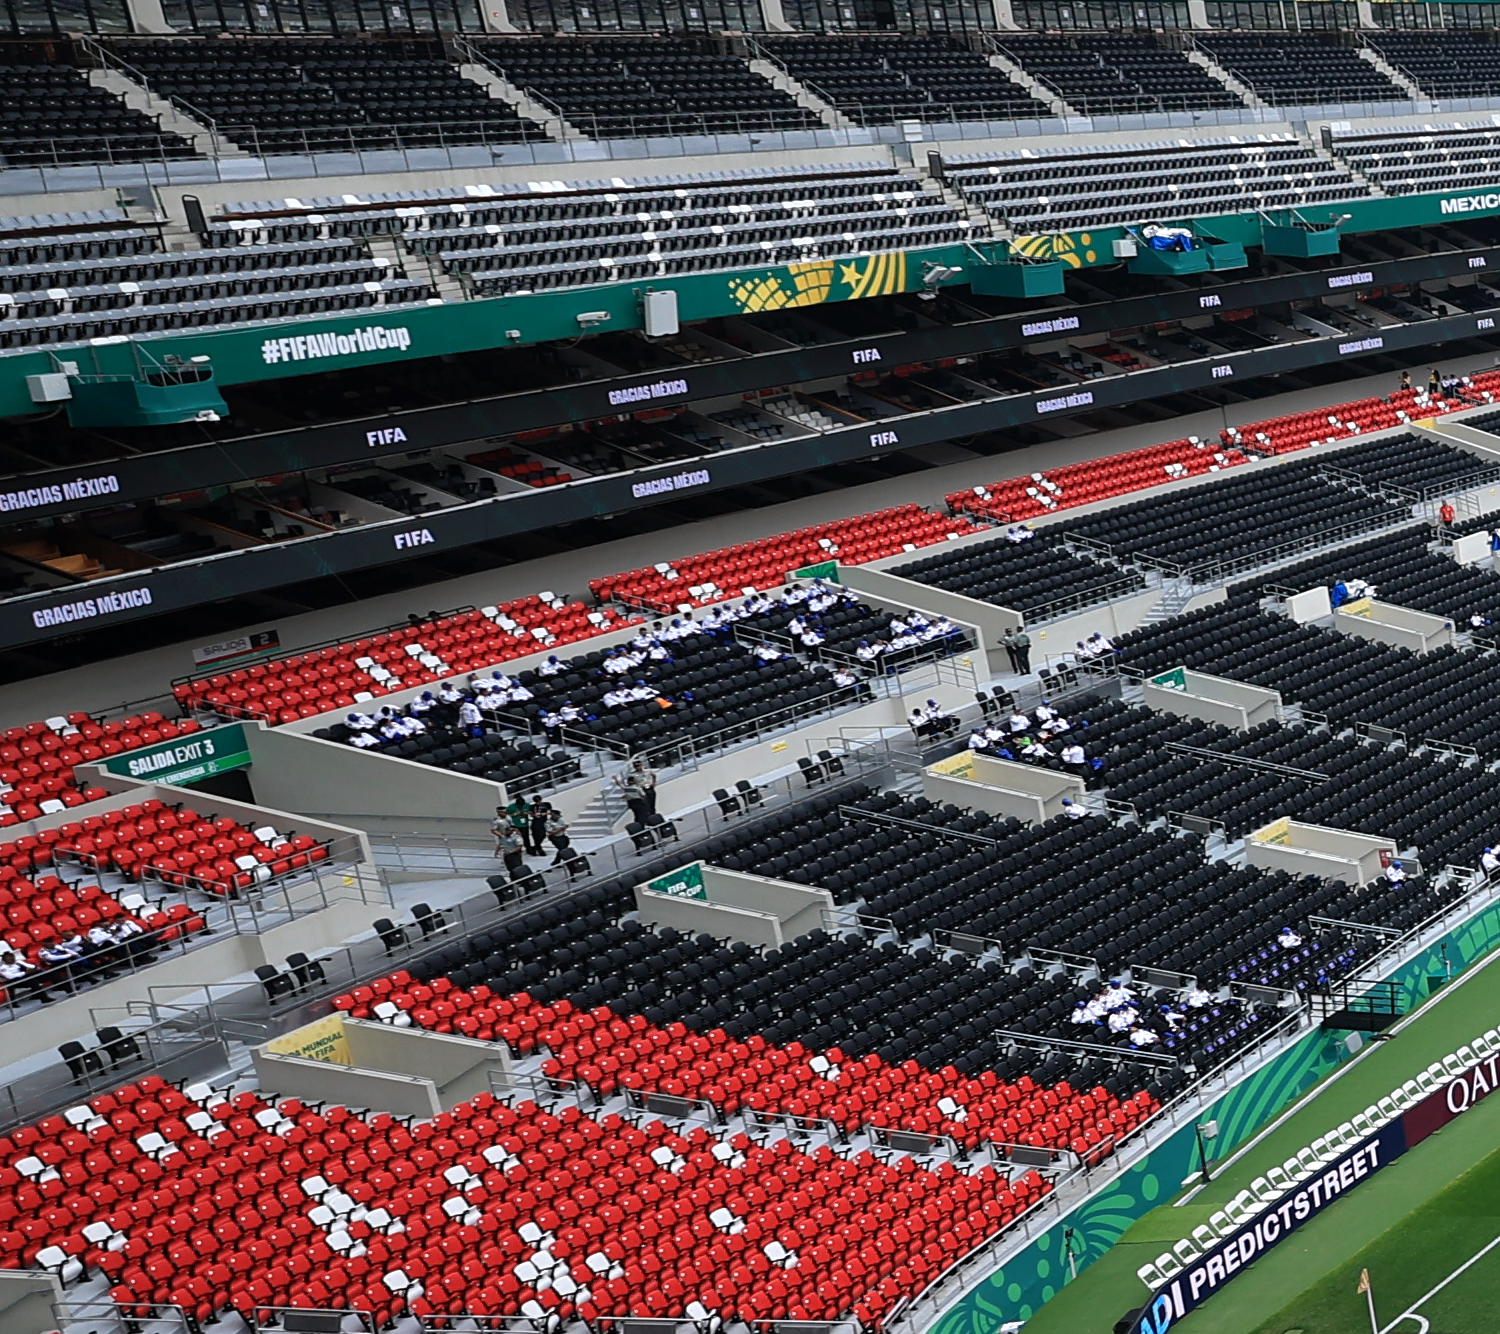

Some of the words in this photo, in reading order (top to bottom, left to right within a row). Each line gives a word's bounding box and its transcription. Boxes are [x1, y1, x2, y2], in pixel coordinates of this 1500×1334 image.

[261, 325, 412, 365] #FIFAWorldCup
[853, 349, 881, 363] FIFA
[609, 386, 650, 405] GRACIAS
[651, 380, 687, 397] MÉXICO
[367, 428, 406, 446] FIFA
[870, 432, 898, 447] FIFA
[0, 486, 62, 511] GRACIAS
[63, 476, 119, 500] MÉXICO
[632, 478, 673, 497] GRACIAS
[674, 470, 709, 489] MÉXICO
[394, 529, 434, 549] FIFA
[33, 600, 96, 627] GRACIAS
[97, 588, 151, 614] MÉXICO
[204, 638, 247, 655] SALIDA
[260, 634, 270, 644] 2
[129, 750, 176, 776] SALIDA
[174, 741, 202, 764] EXIT
[203, 739, 215, 755] 3
[303, 1031, 344, 1053] MUNDIAL
[316, 1044, 336, 1057] FIFA
[1188, 1140, 1381, 1303] PREDICTSTREET
